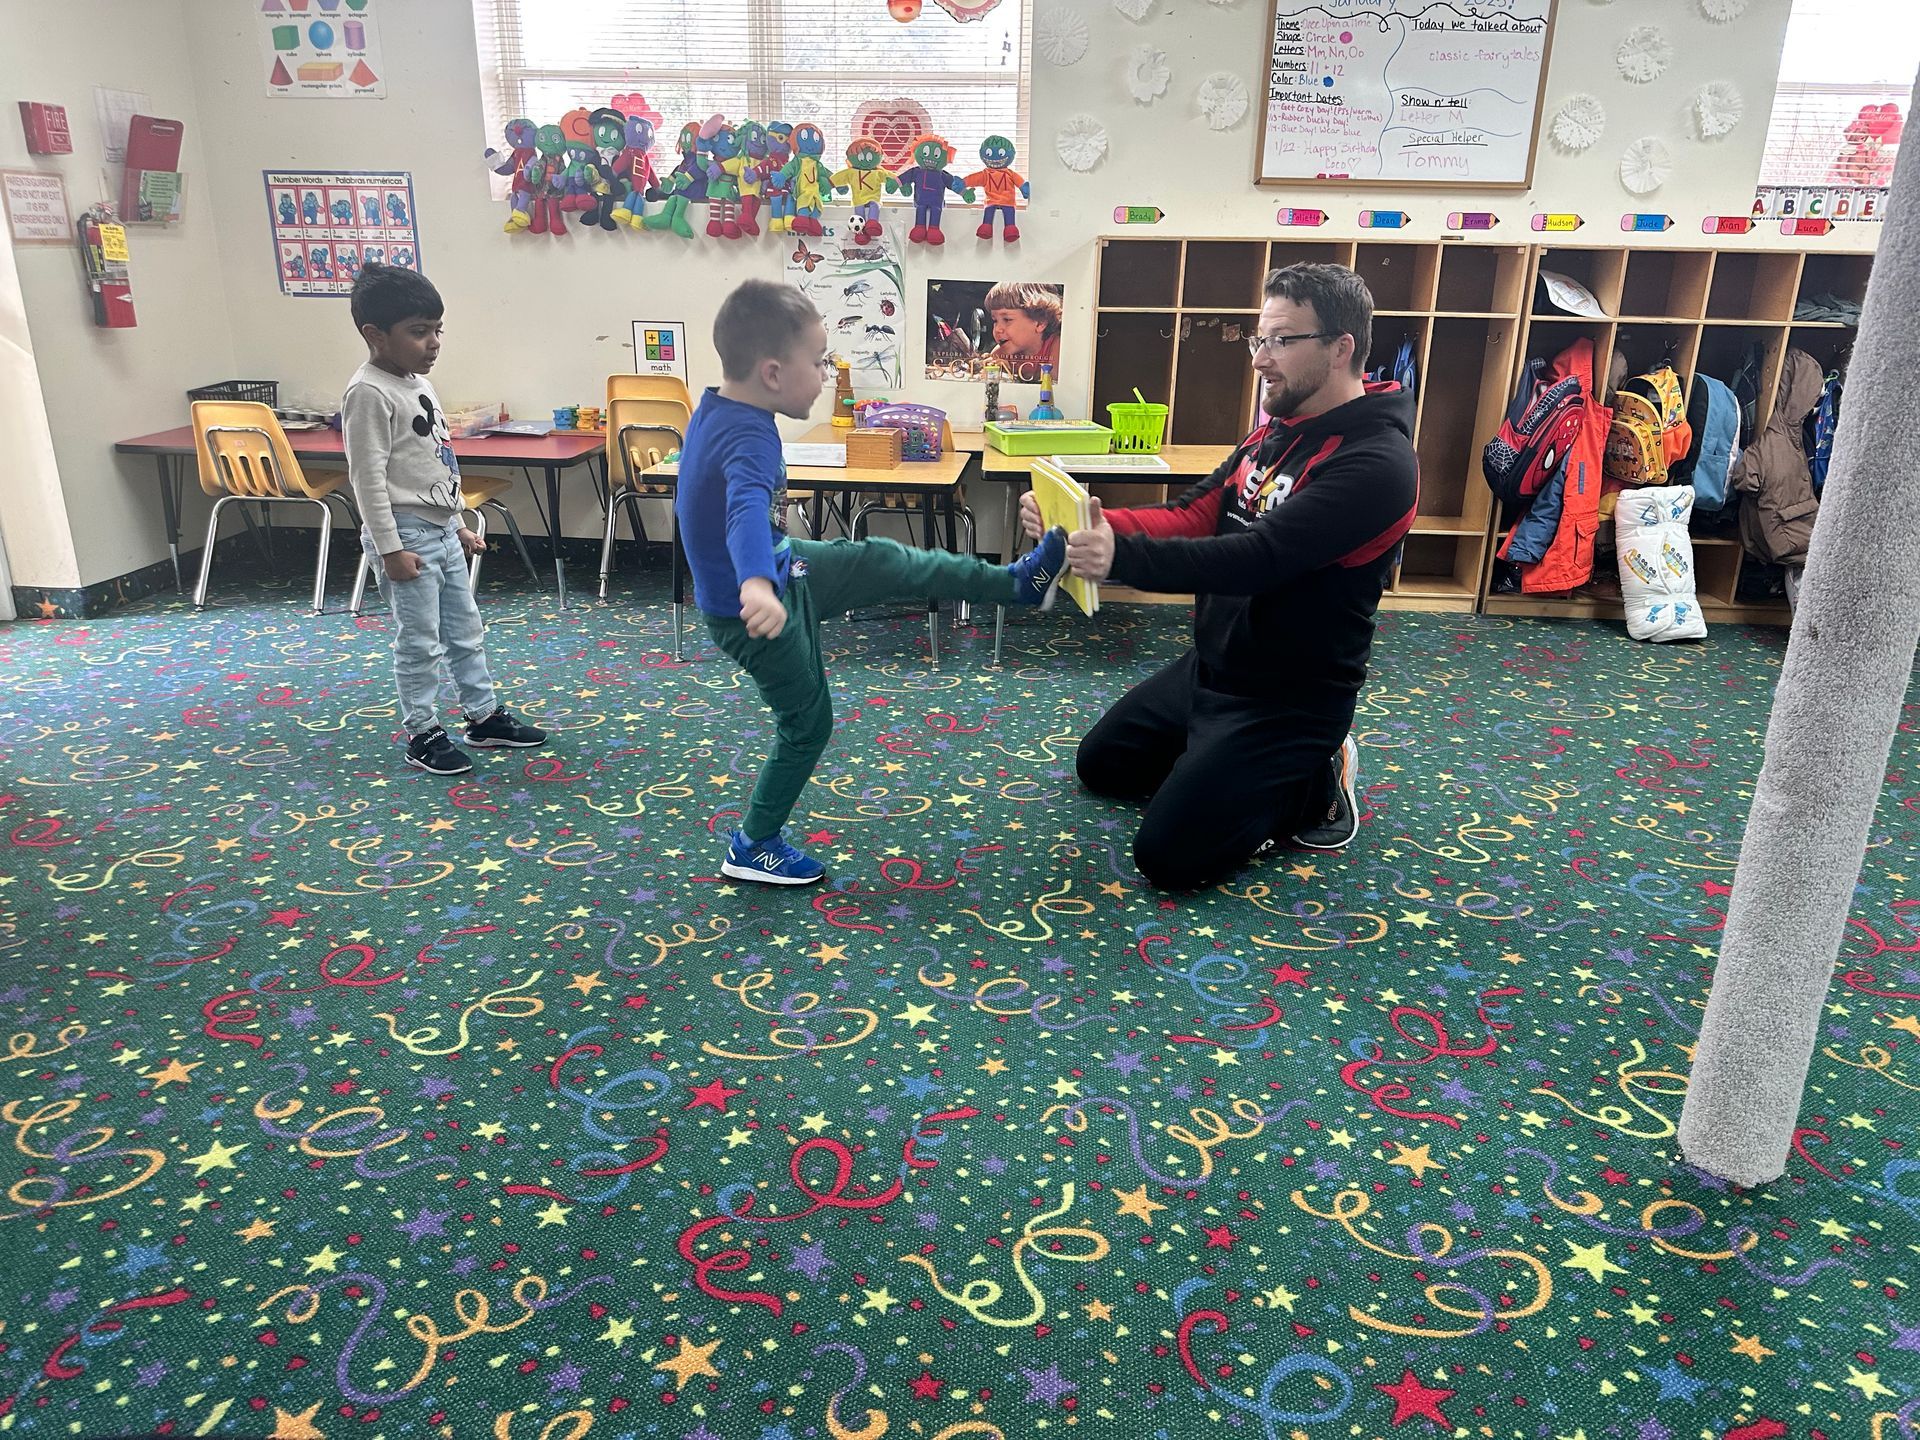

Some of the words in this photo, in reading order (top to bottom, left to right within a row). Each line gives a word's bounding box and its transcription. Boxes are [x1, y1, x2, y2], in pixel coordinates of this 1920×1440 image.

[1412, 18, 1444, 33] Today
[1452, 20, 1465, 29] we
[1471, 19, 1508, 31] talked
[1511, 21, 1542, 33] about
[1305, 32, 1336, 43] Circle
[1429, 49, 1471, 62] classic
[1333, 64, 1344, 76] 12
[1298, 74, 1319, 86] Blue
[1269, 88, 1312, 101] Important
[1401, 94, 1433, 107] Show
[1296, 104, 1315, 114] Cozy
[46, 110, 67, 130] FIRE
[1449, 110, 1464, 124] M
[1343, 128, 1361, 136] blue
[1409, 133, 1444, 144] Special
[1452, 131, 1484, 144] Helper
[1304, 141, 1337, 157] Happy
[633, 156, 646, 178] E
[1398, 151, 1470, 176] Tommy
[274, 176, 301, 184] Number
[302, 176, 323, 184] Words
[804, 166, 816, 184] J
[859, 170, 874, 191] K
[922, 171, 936, 191] L
[989, 173, 1007, 192] M
[1752, 199, 1764, 214] A
[1783, 199, 1795, 214] B
[1810, 199, 1822, 215] C
[1837, 199, 1850, 215] D
[1864, 200, 1874, 215] E
[1130, 211, 1151, 222] Brady
[1375, 215, 1395, 225] Dean
[1548, 218, 1573, 227] Hudson
[1637, 218, 1659, 228] Jude
[1720, 221, 1740, 230] Kian
[1797, 222, 1818, 233] Luca
[650, 363, 672, 371] math
[423, 730, 445, 746] NAUTICA
